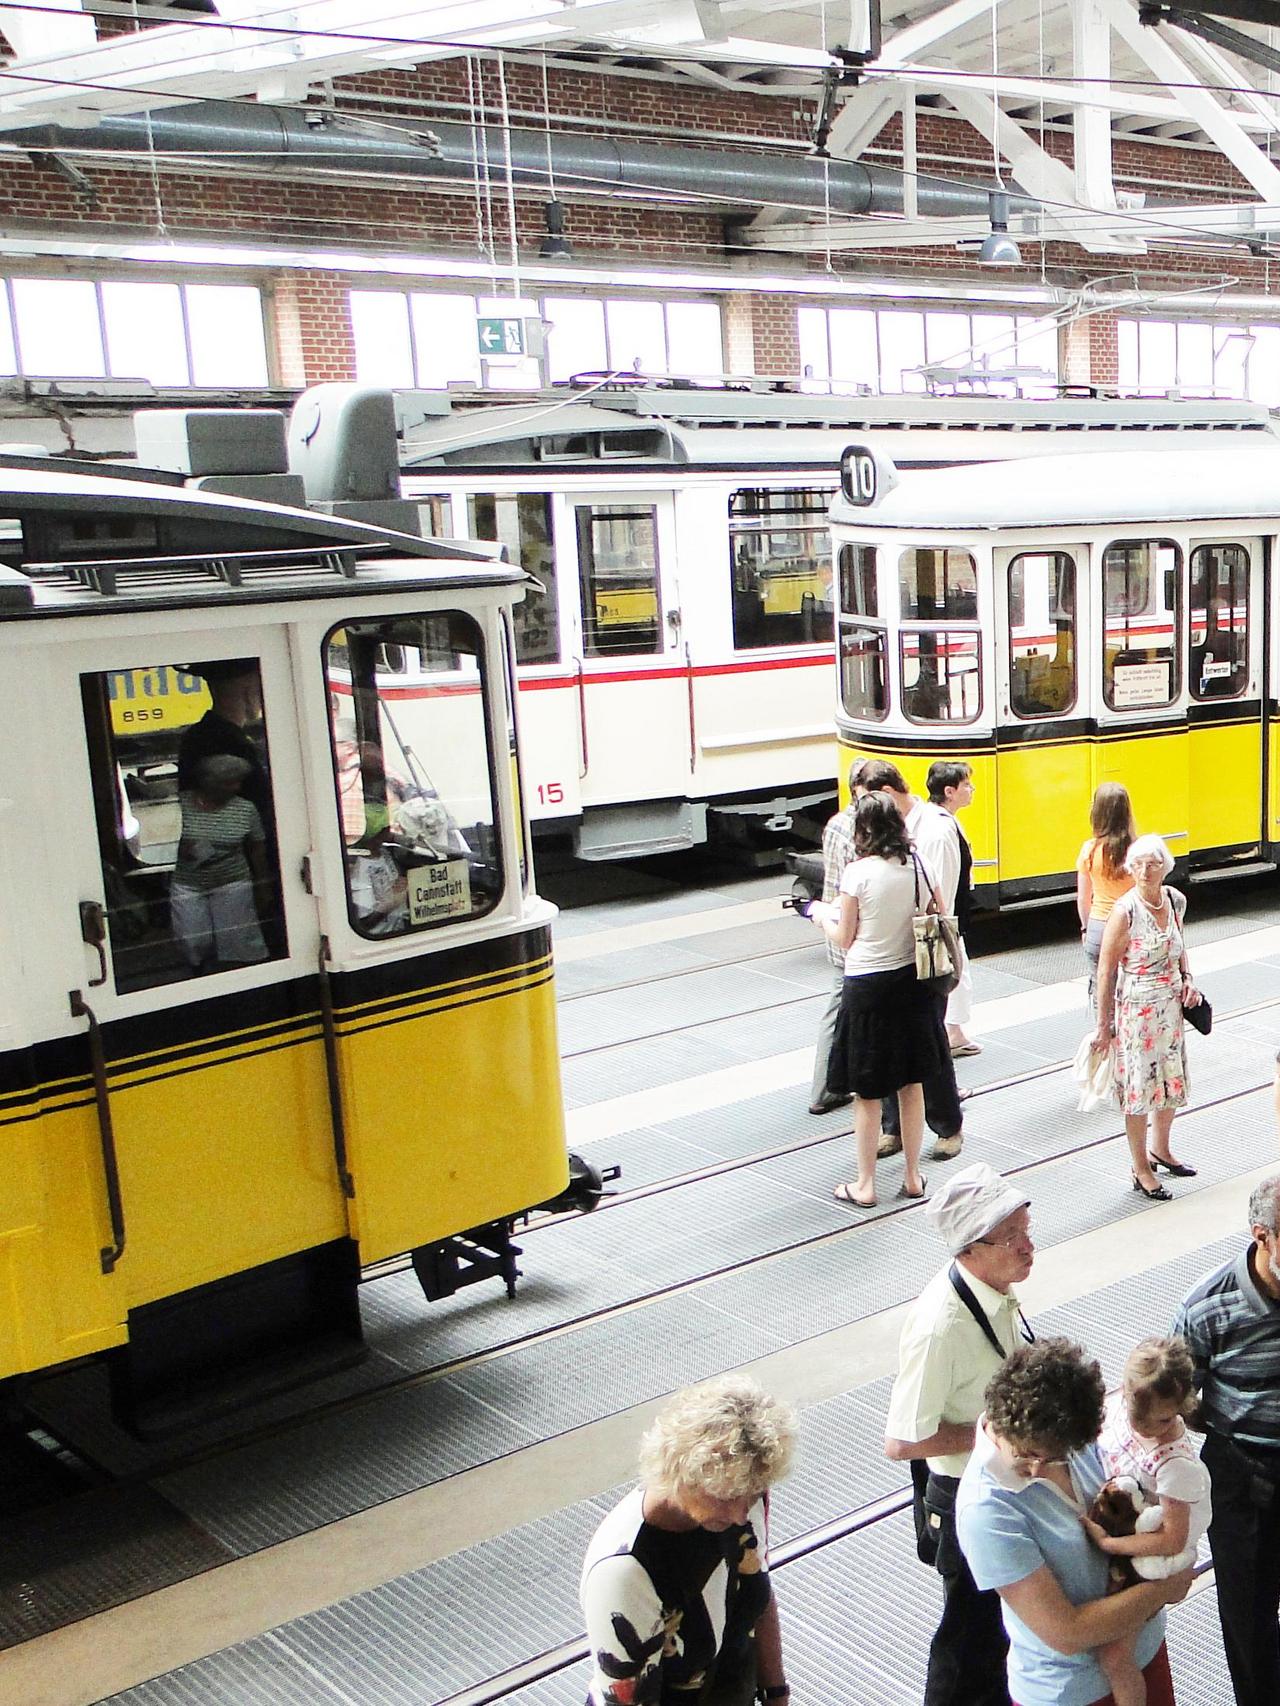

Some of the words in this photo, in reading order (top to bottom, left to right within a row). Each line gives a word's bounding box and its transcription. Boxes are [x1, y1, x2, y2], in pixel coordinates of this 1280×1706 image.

[849, 455, 875, 498] 10
[123, 707, 164, 722] 859
[537, 782, 564, 805] 15
[430, 866, 449, 884] Bad
[416, 879, 463, 903] Cannstatt
